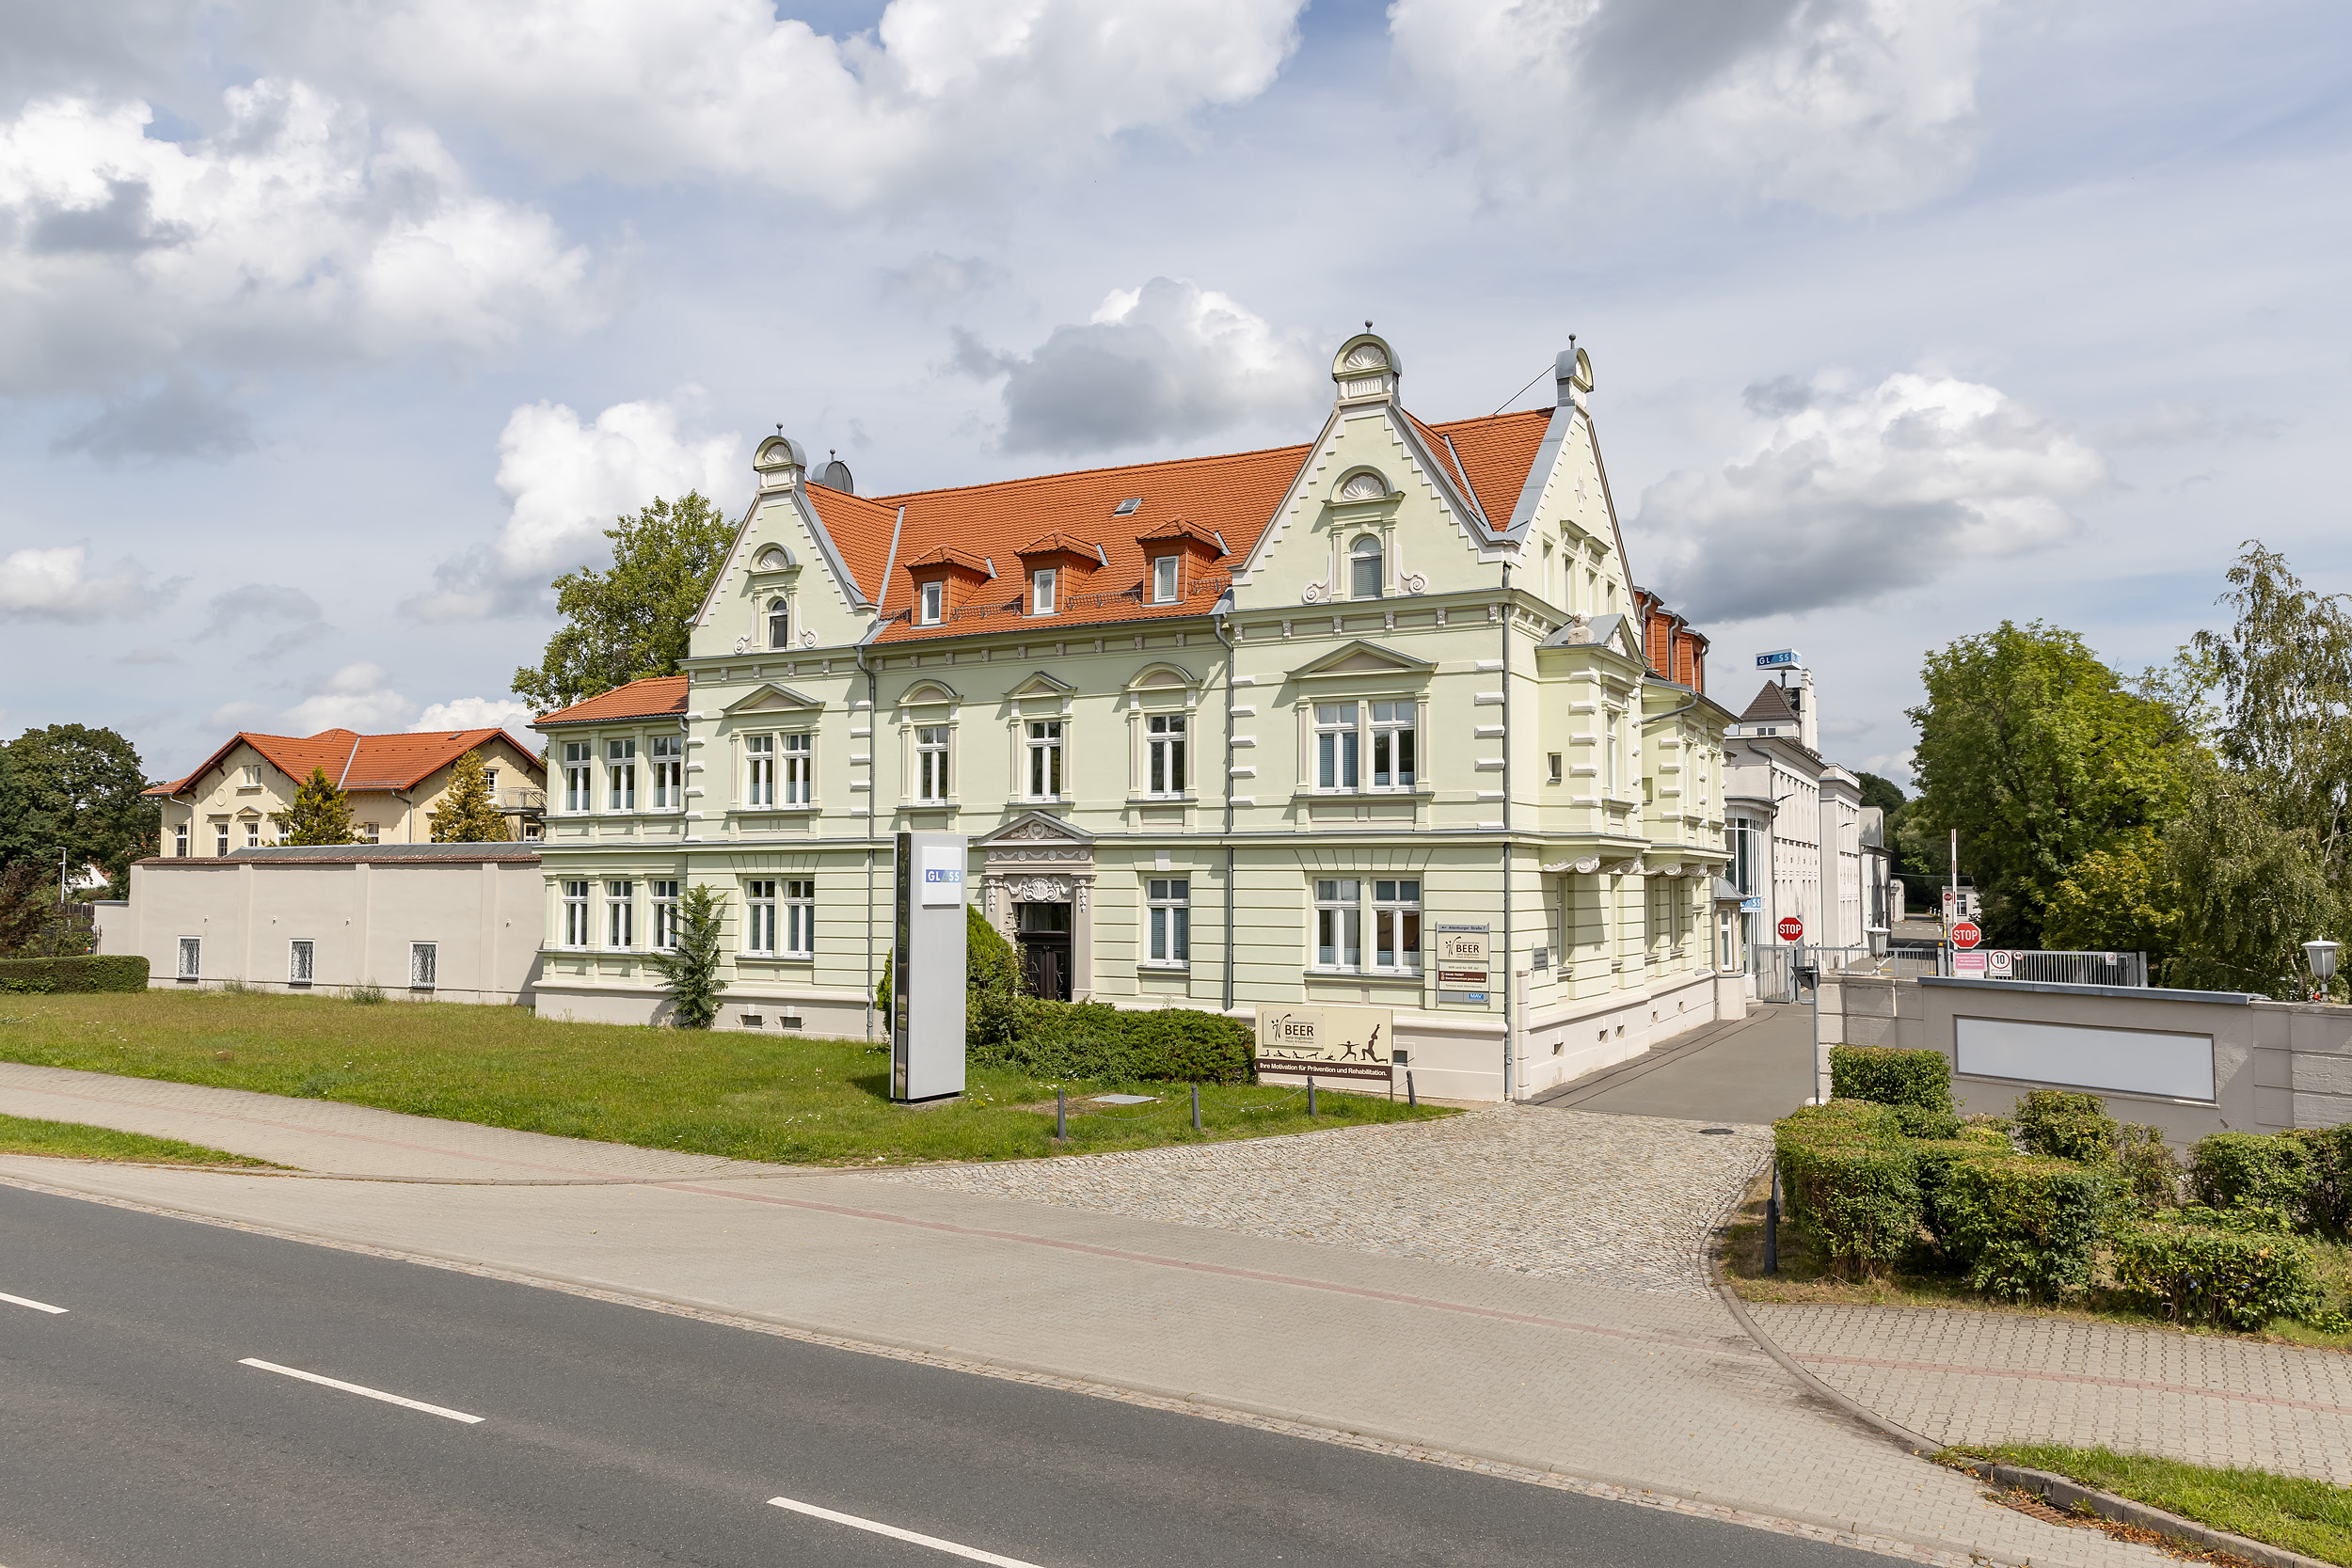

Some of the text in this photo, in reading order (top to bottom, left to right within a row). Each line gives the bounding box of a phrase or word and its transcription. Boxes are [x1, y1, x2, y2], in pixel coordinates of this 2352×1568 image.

[928, 870, 960, 882] GLASS
[1740, 898, 1760, 908] LASS
[1779, 924, 1802, 934] STOP
[1953, 929, 1978, 941] STOP
[1456, 944, 1480, 953] BEER
[1995, 955, 2005, 964] 10
[1285, 1024, 1314, 1037] BEER
[1348, 1068, 1388, 1076] Rehabilitation.
